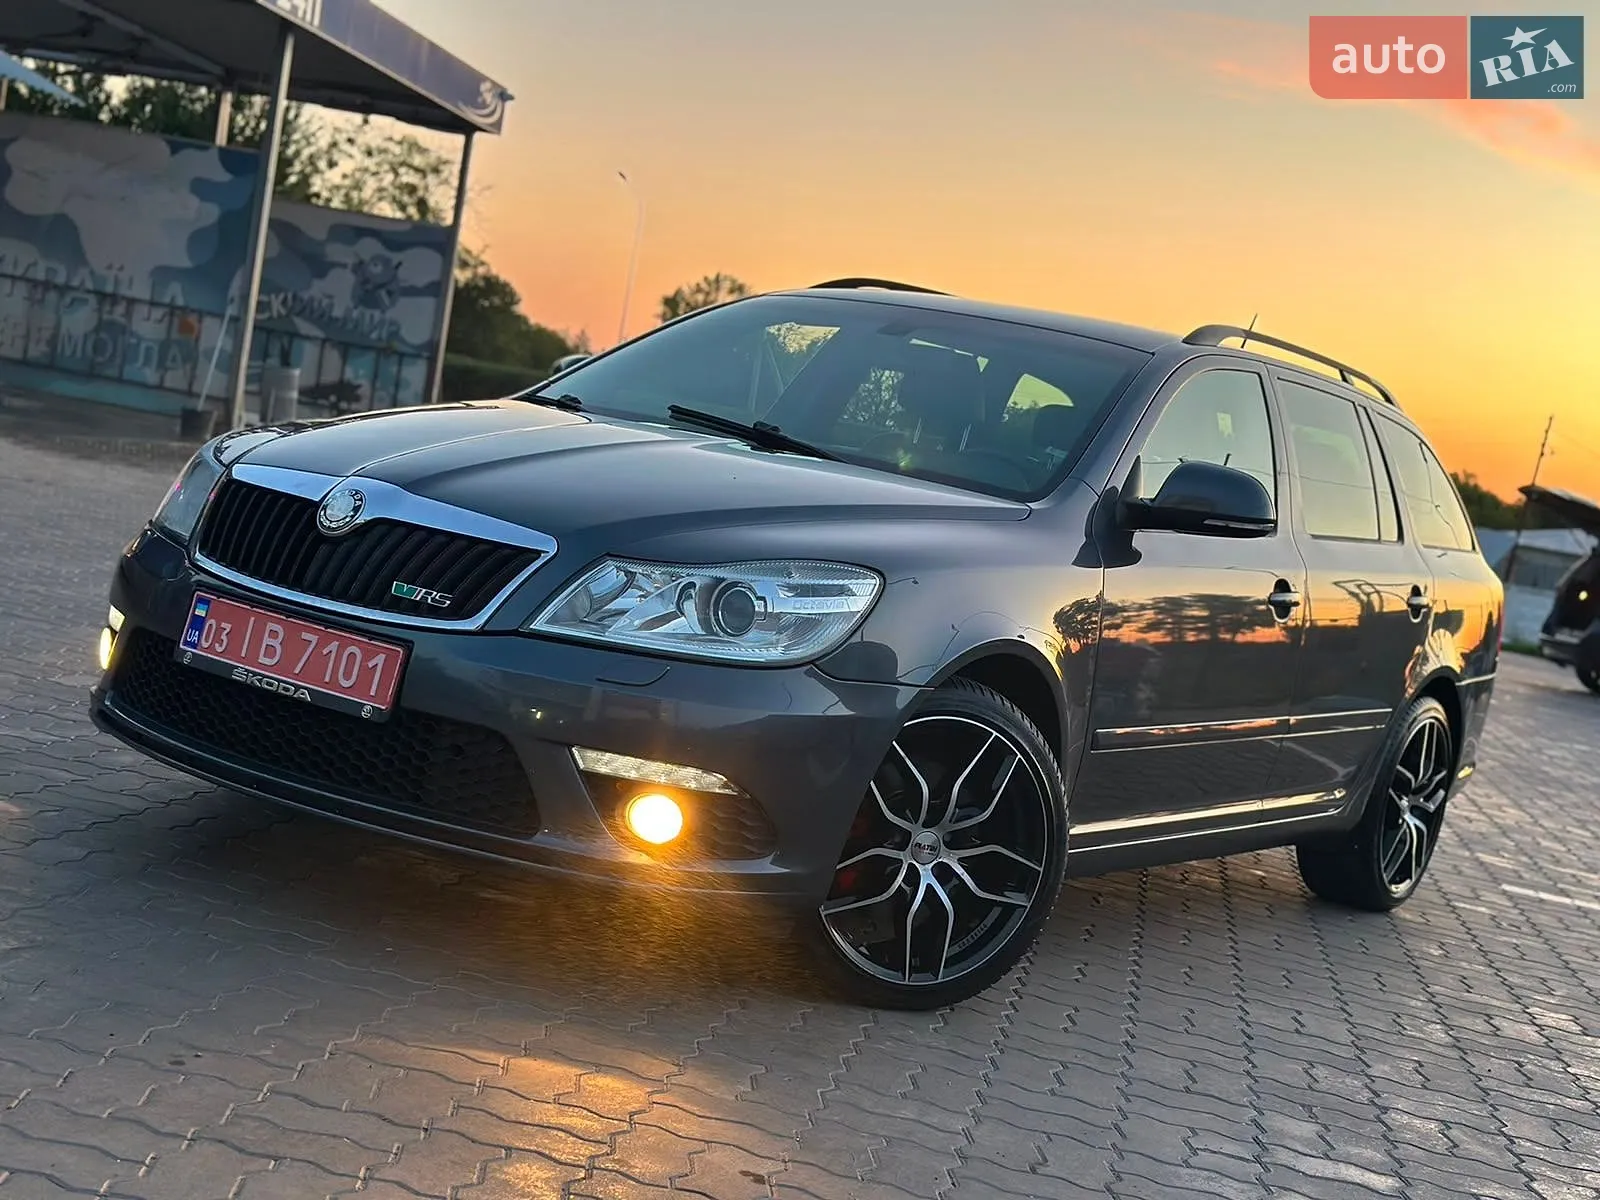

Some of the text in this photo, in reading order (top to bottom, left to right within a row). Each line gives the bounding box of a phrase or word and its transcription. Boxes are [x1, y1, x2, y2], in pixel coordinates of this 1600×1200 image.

[187, 628, 199, 643] UA
[201, 619, 232, 653] 03
[293, 631, 387, 697] 7101
[232, 667, 312, 702] ŠKODA
